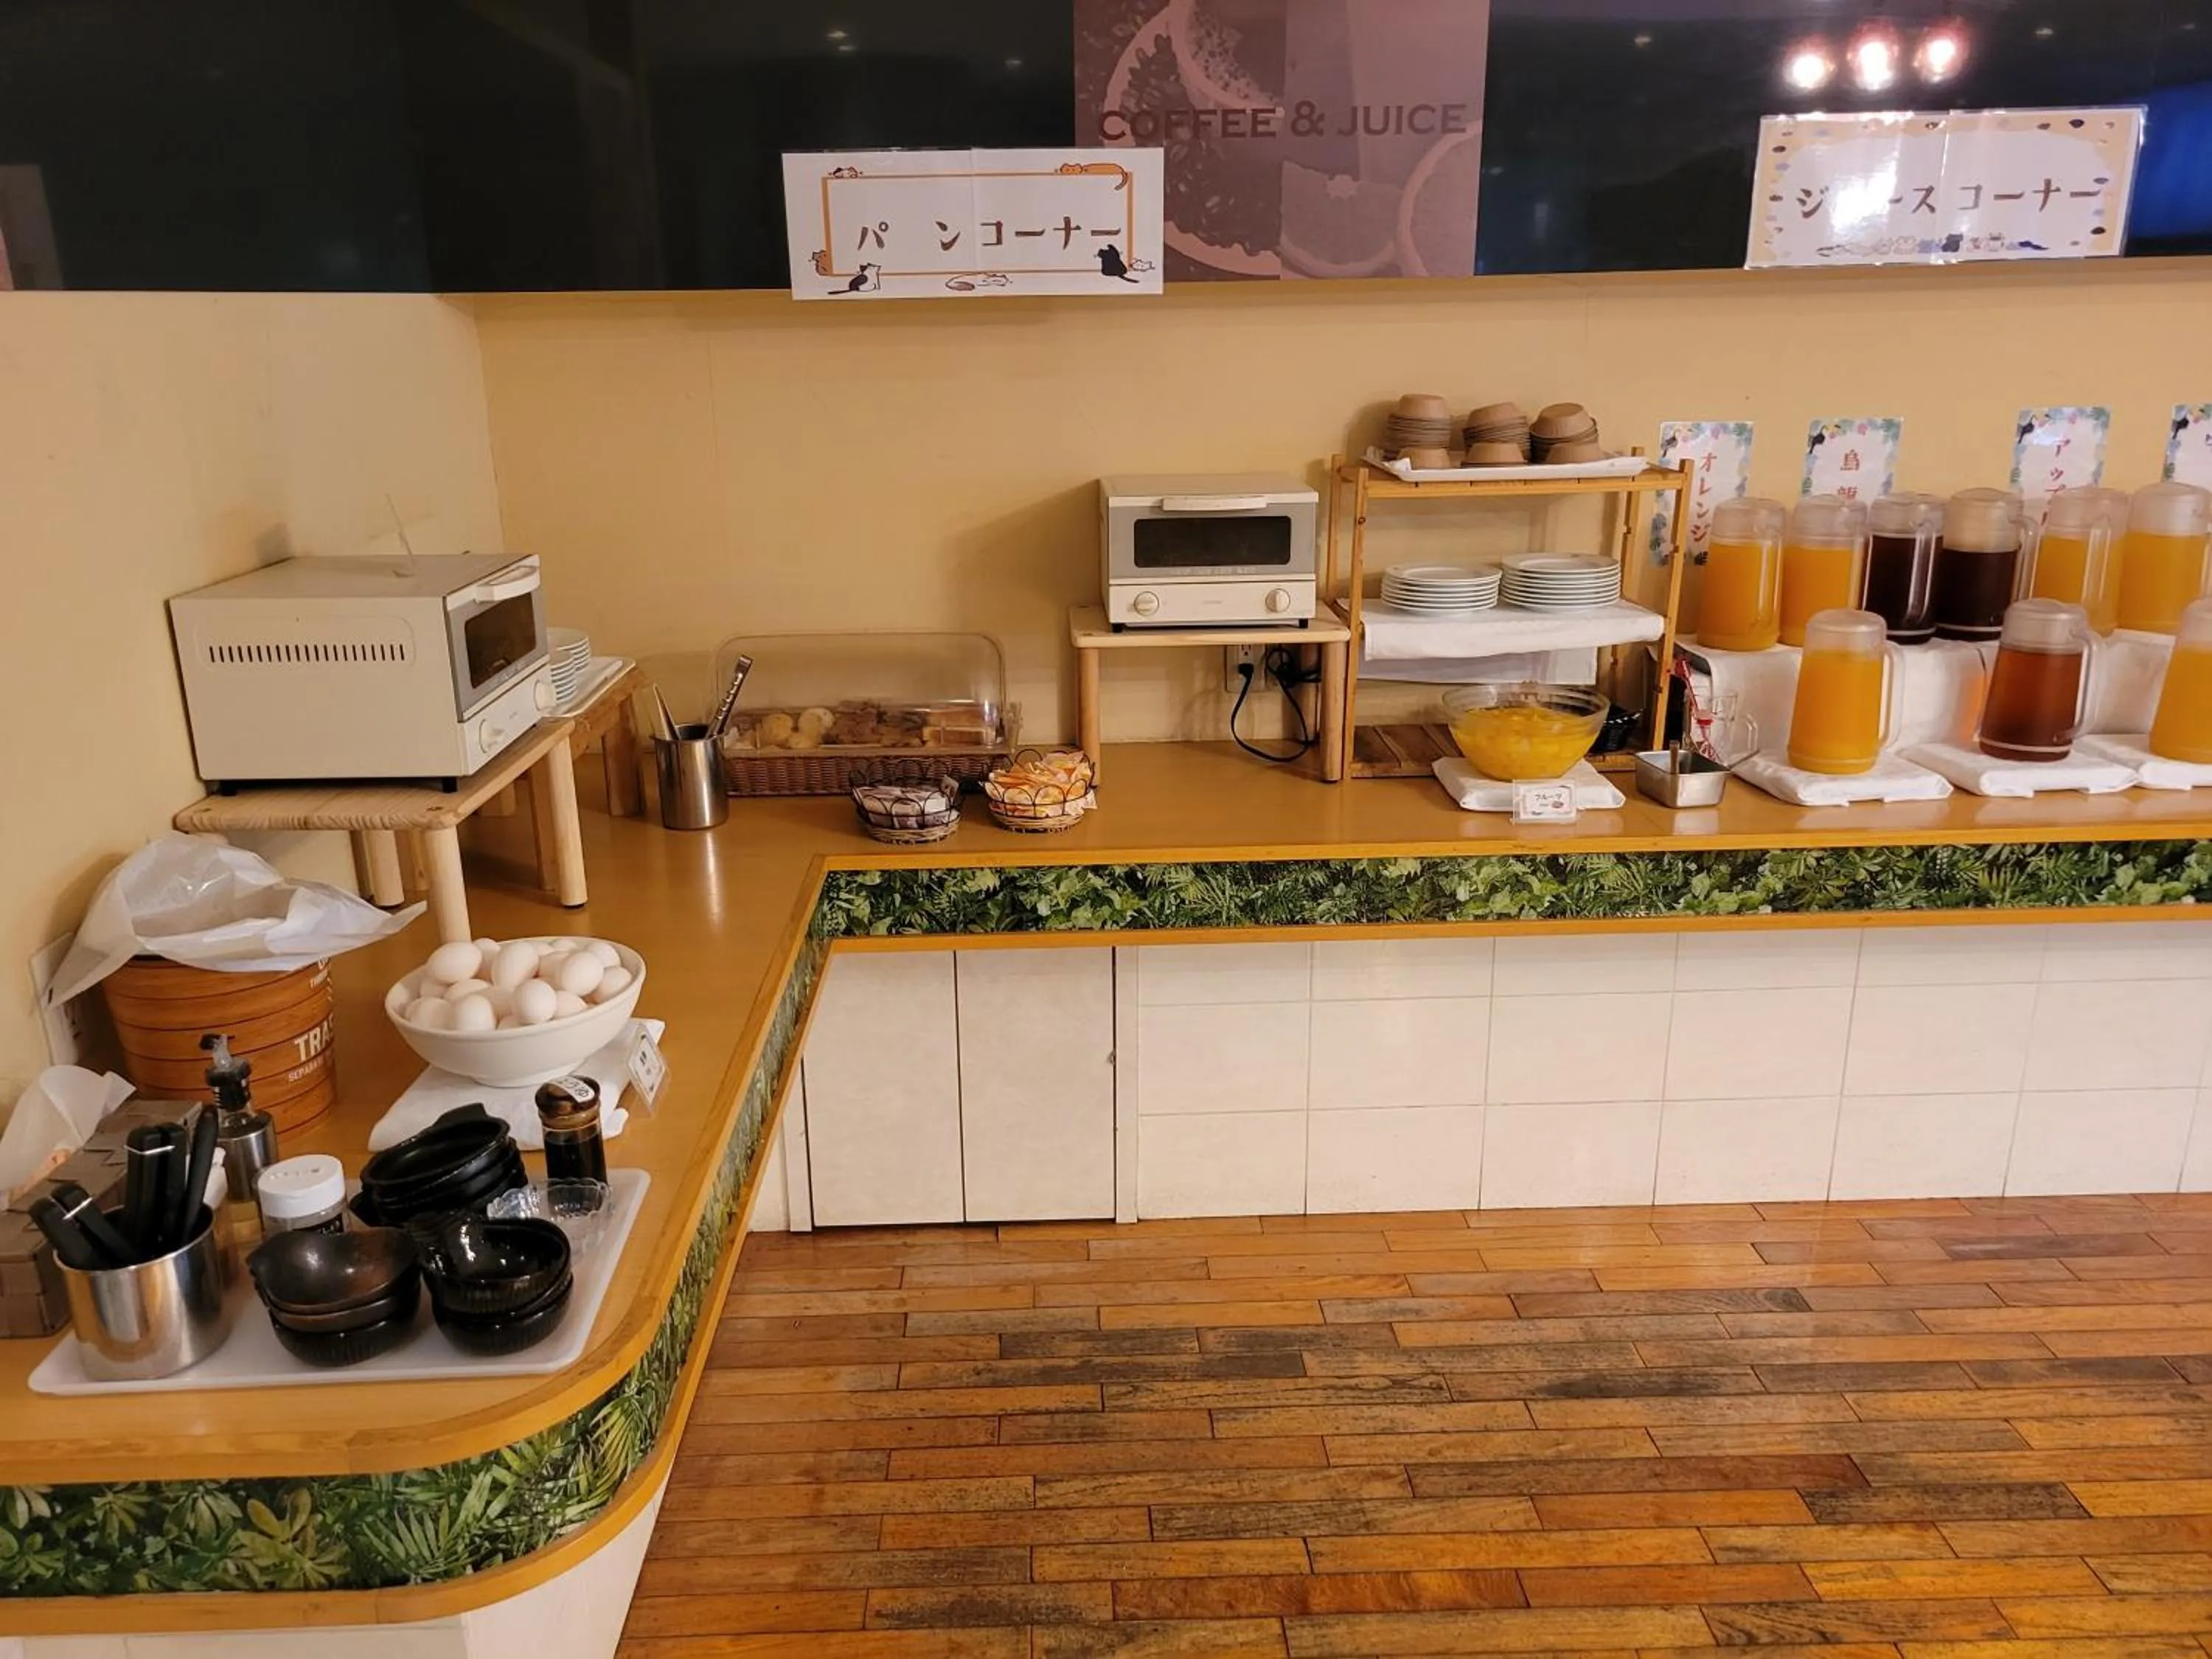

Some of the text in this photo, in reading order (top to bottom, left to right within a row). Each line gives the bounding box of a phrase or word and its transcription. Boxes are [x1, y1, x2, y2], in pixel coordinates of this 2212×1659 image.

[1099, 100, 1467, 141] COFFEE & JUICE
[1795, 178, 2101, 219] ジスコーナー
[1691, 452, 1717, 542] オレンジ
